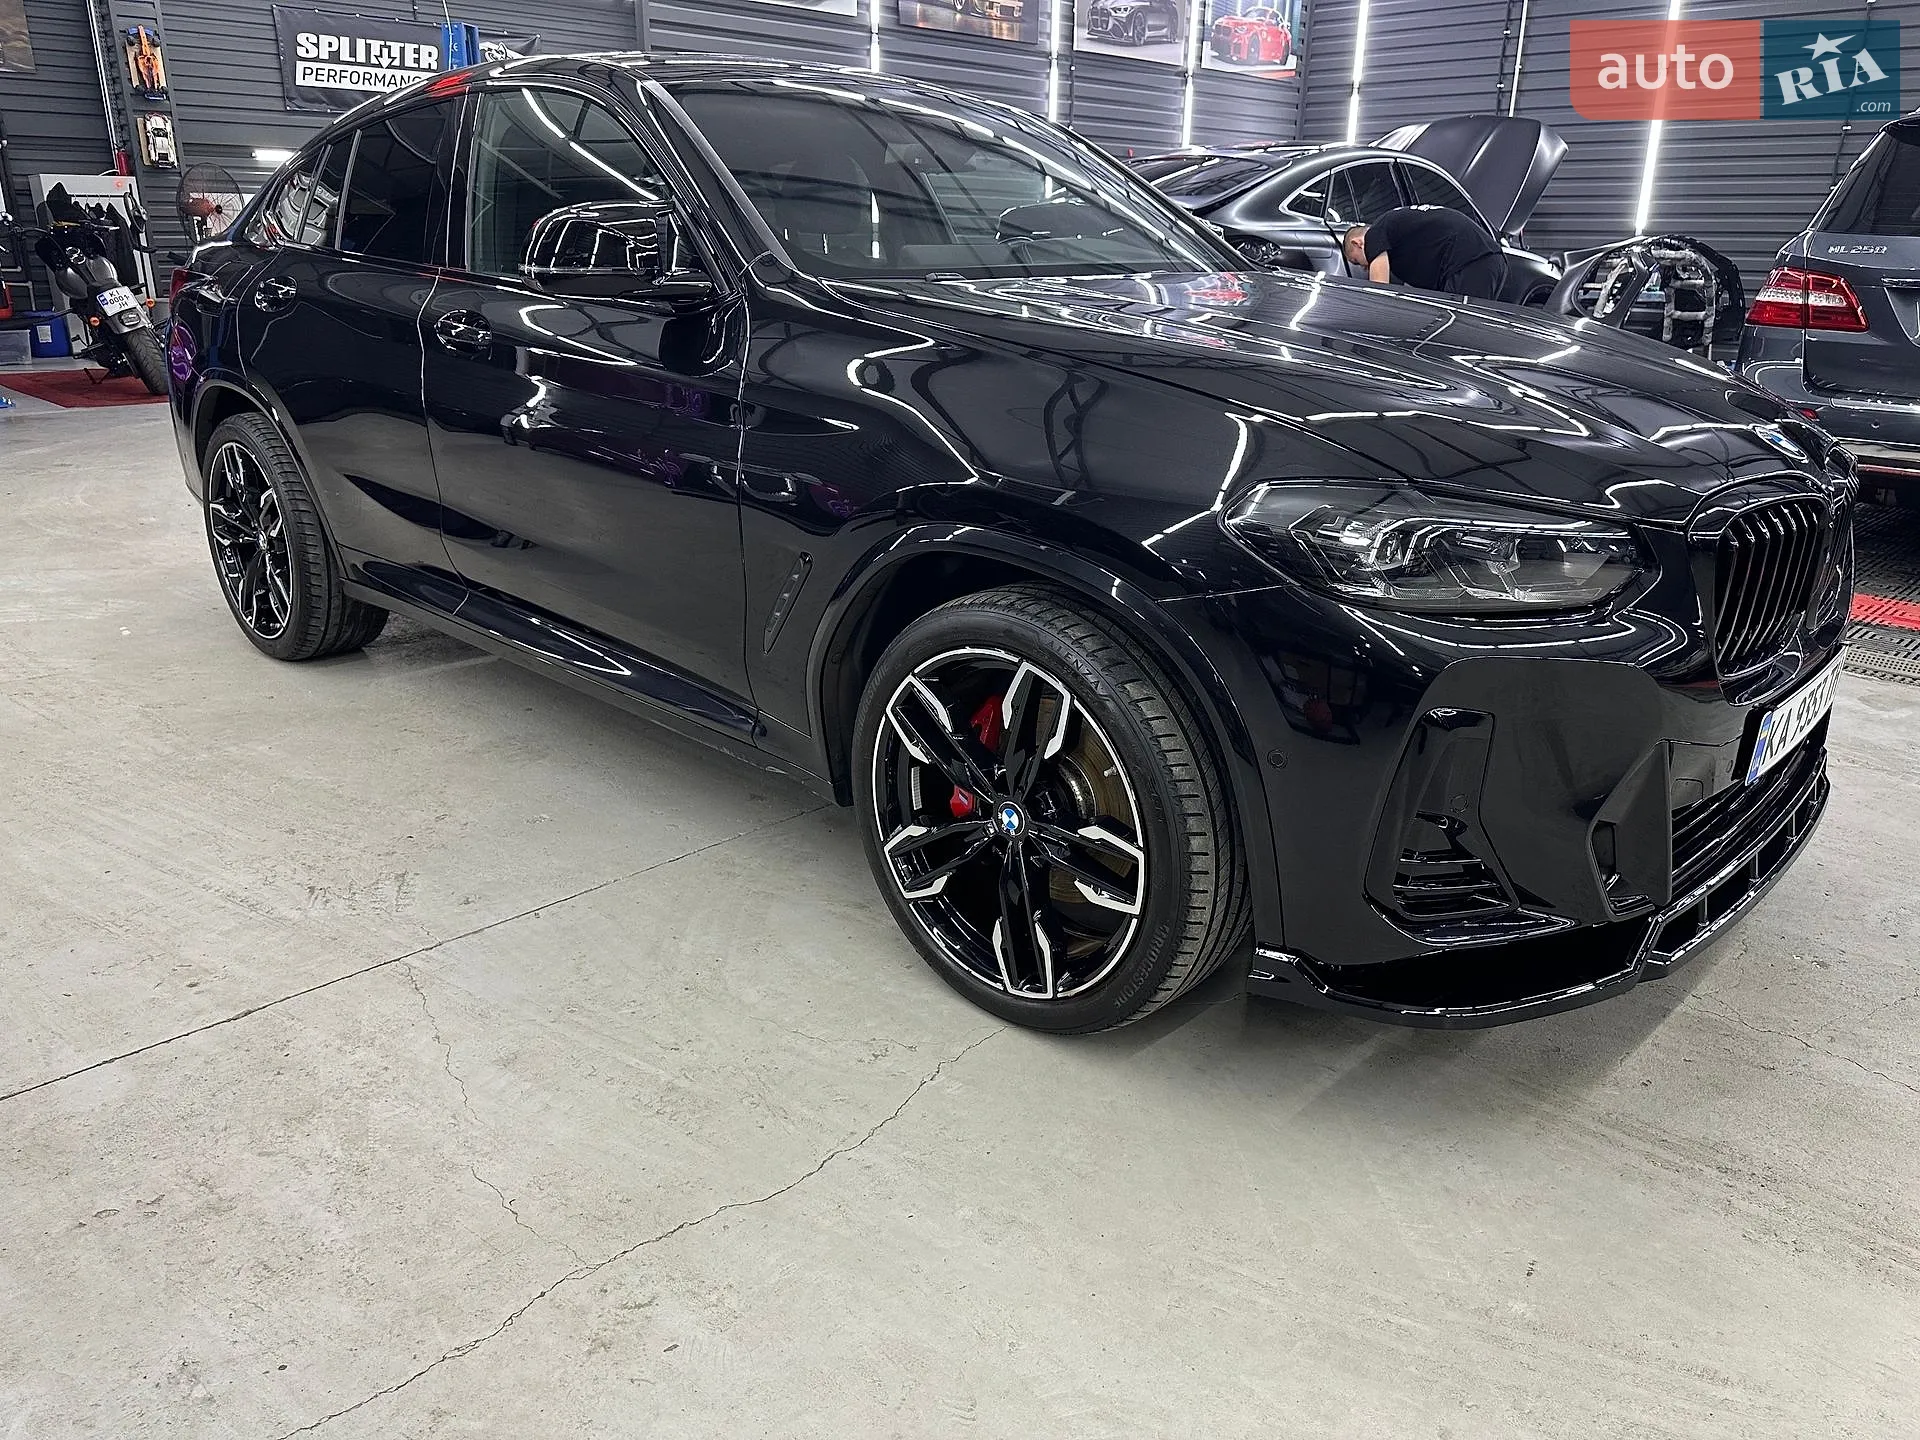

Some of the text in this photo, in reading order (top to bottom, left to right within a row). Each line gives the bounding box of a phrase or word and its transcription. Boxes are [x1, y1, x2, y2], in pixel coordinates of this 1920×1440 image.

[296, 32, 439, 71] SPLITTER
[302, 67, 422, 88] PERFORMAN
[1828, 245, 1848, 254] ML
[1761, 707, 1793, 766] KA
